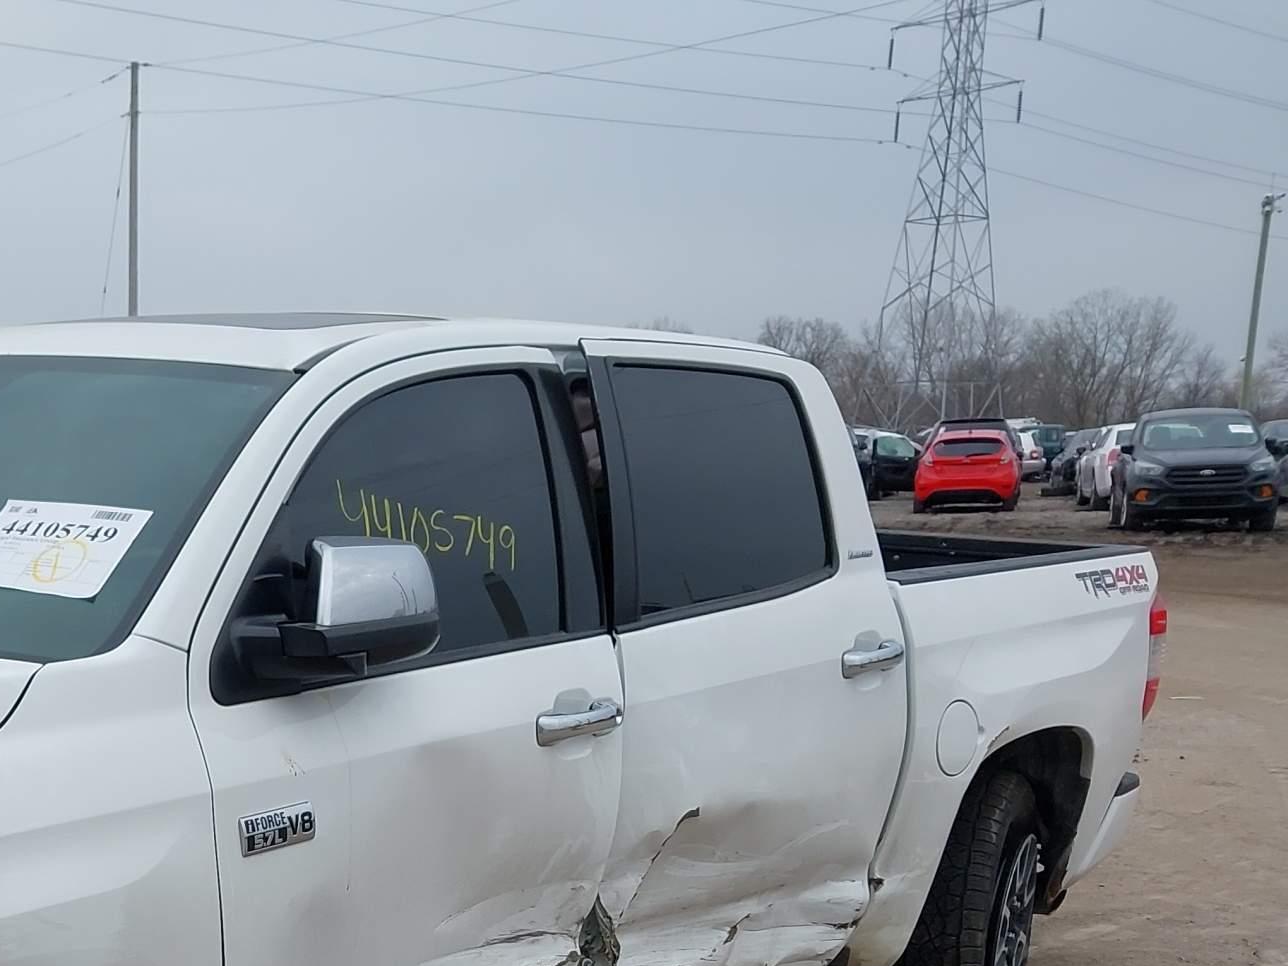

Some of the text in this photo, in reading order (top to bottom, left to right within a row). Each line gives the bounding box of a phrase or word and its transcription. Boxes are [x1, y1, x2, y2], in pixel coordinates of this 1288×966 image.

[1, 519, 119, 543] 44105749
[336, 479, 515, 571] 44105749
[287, 811, 314, 836] V8
